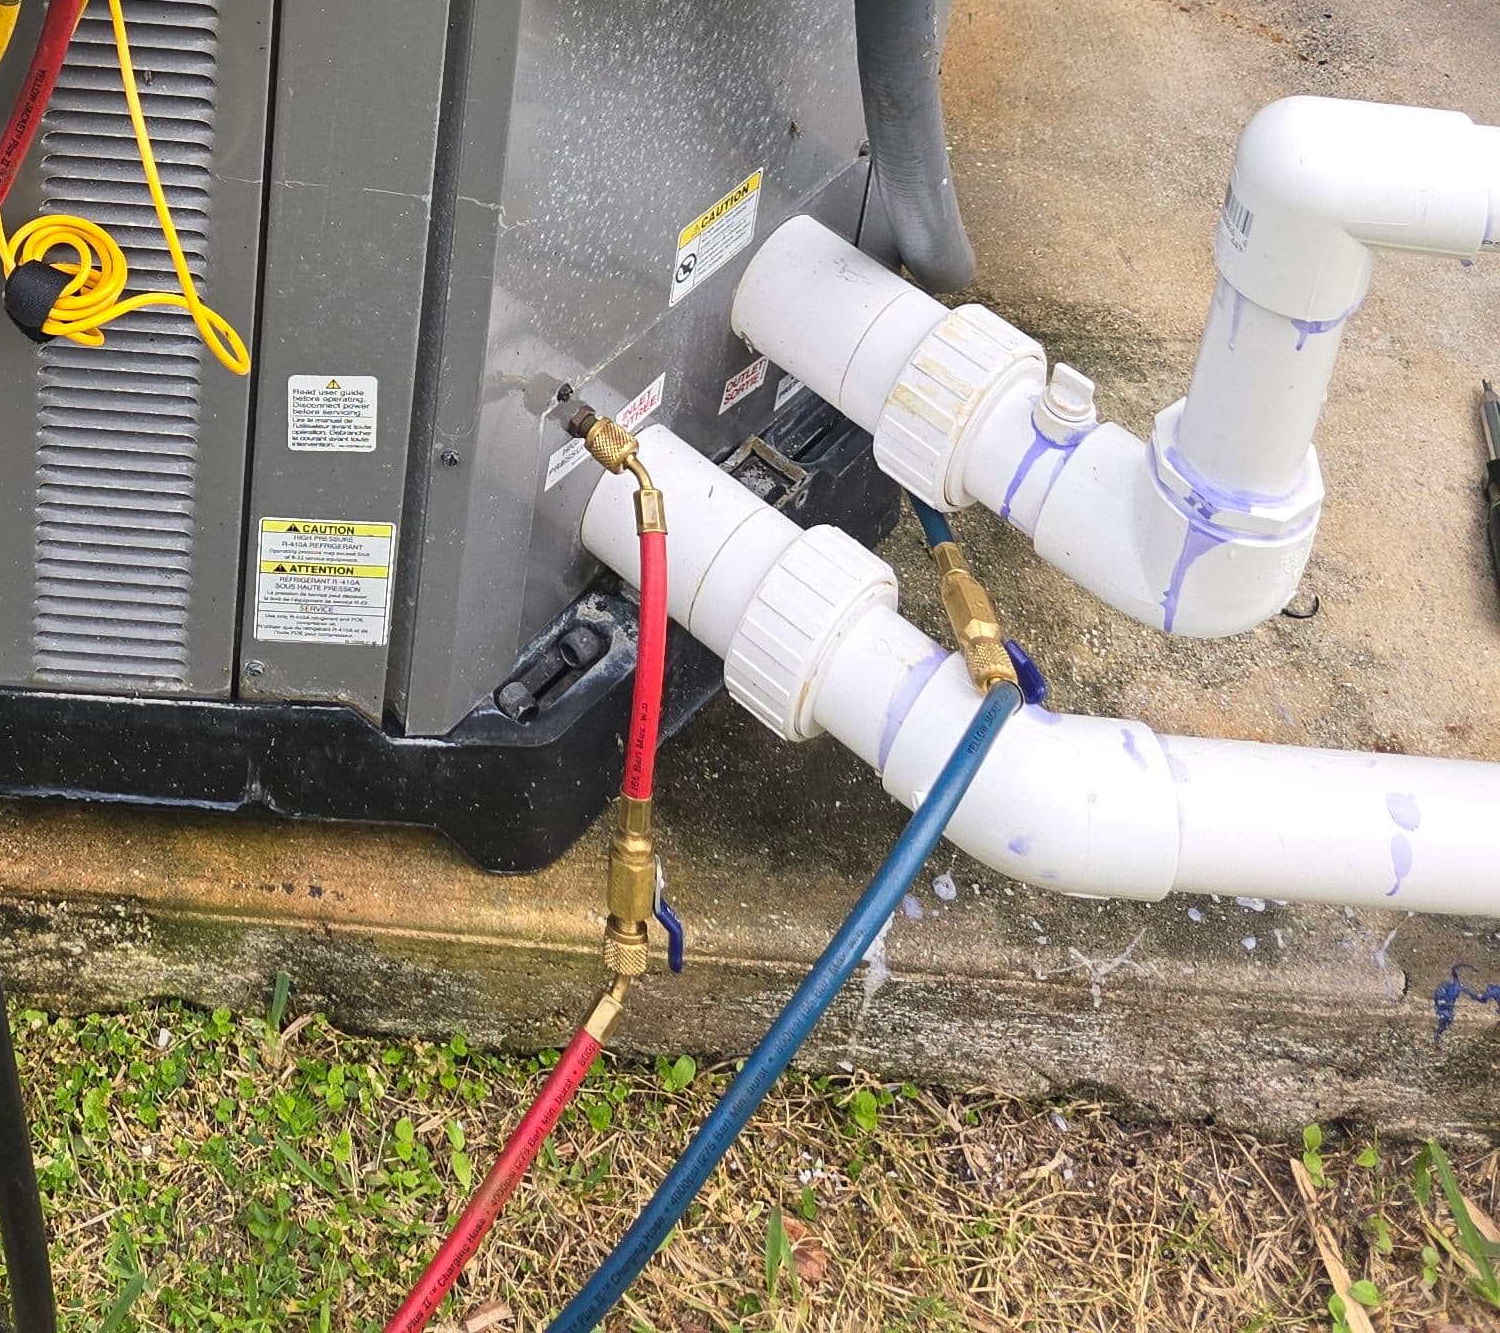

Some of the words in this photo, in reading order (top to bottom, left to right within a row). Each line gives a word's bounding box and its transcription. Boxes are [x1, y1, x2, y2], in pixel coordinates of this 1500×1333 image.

[31, 68, 47, 102] YELLOW
[700, 183, 750, 229] CAUTION
[726, 358, 767, 393] OUTLET
[340, 389, 364, 397] guide
[724, 375, 759, 405] SORTIE
[292, 401, 340, 409] Disconnect
[302, 525, 355, 535] CAUTION
[309, 543, 364, 551] REFRIGERANT
[289, 565, 354, 575] ATTENTION
[323, 585, 361, 593] PRESSION
[300, 605, 334, 613] SERVICE
[966, 725, 988, 756] YELLOW
[438, 1245, 470, 1287] Charging
[468, 1218, 486, 1245] Hose
[556, 1077, 574, 1104] burst
[610, 1241, 648, 1285] Charging
[643, 1214, 664, 1242] Hose
